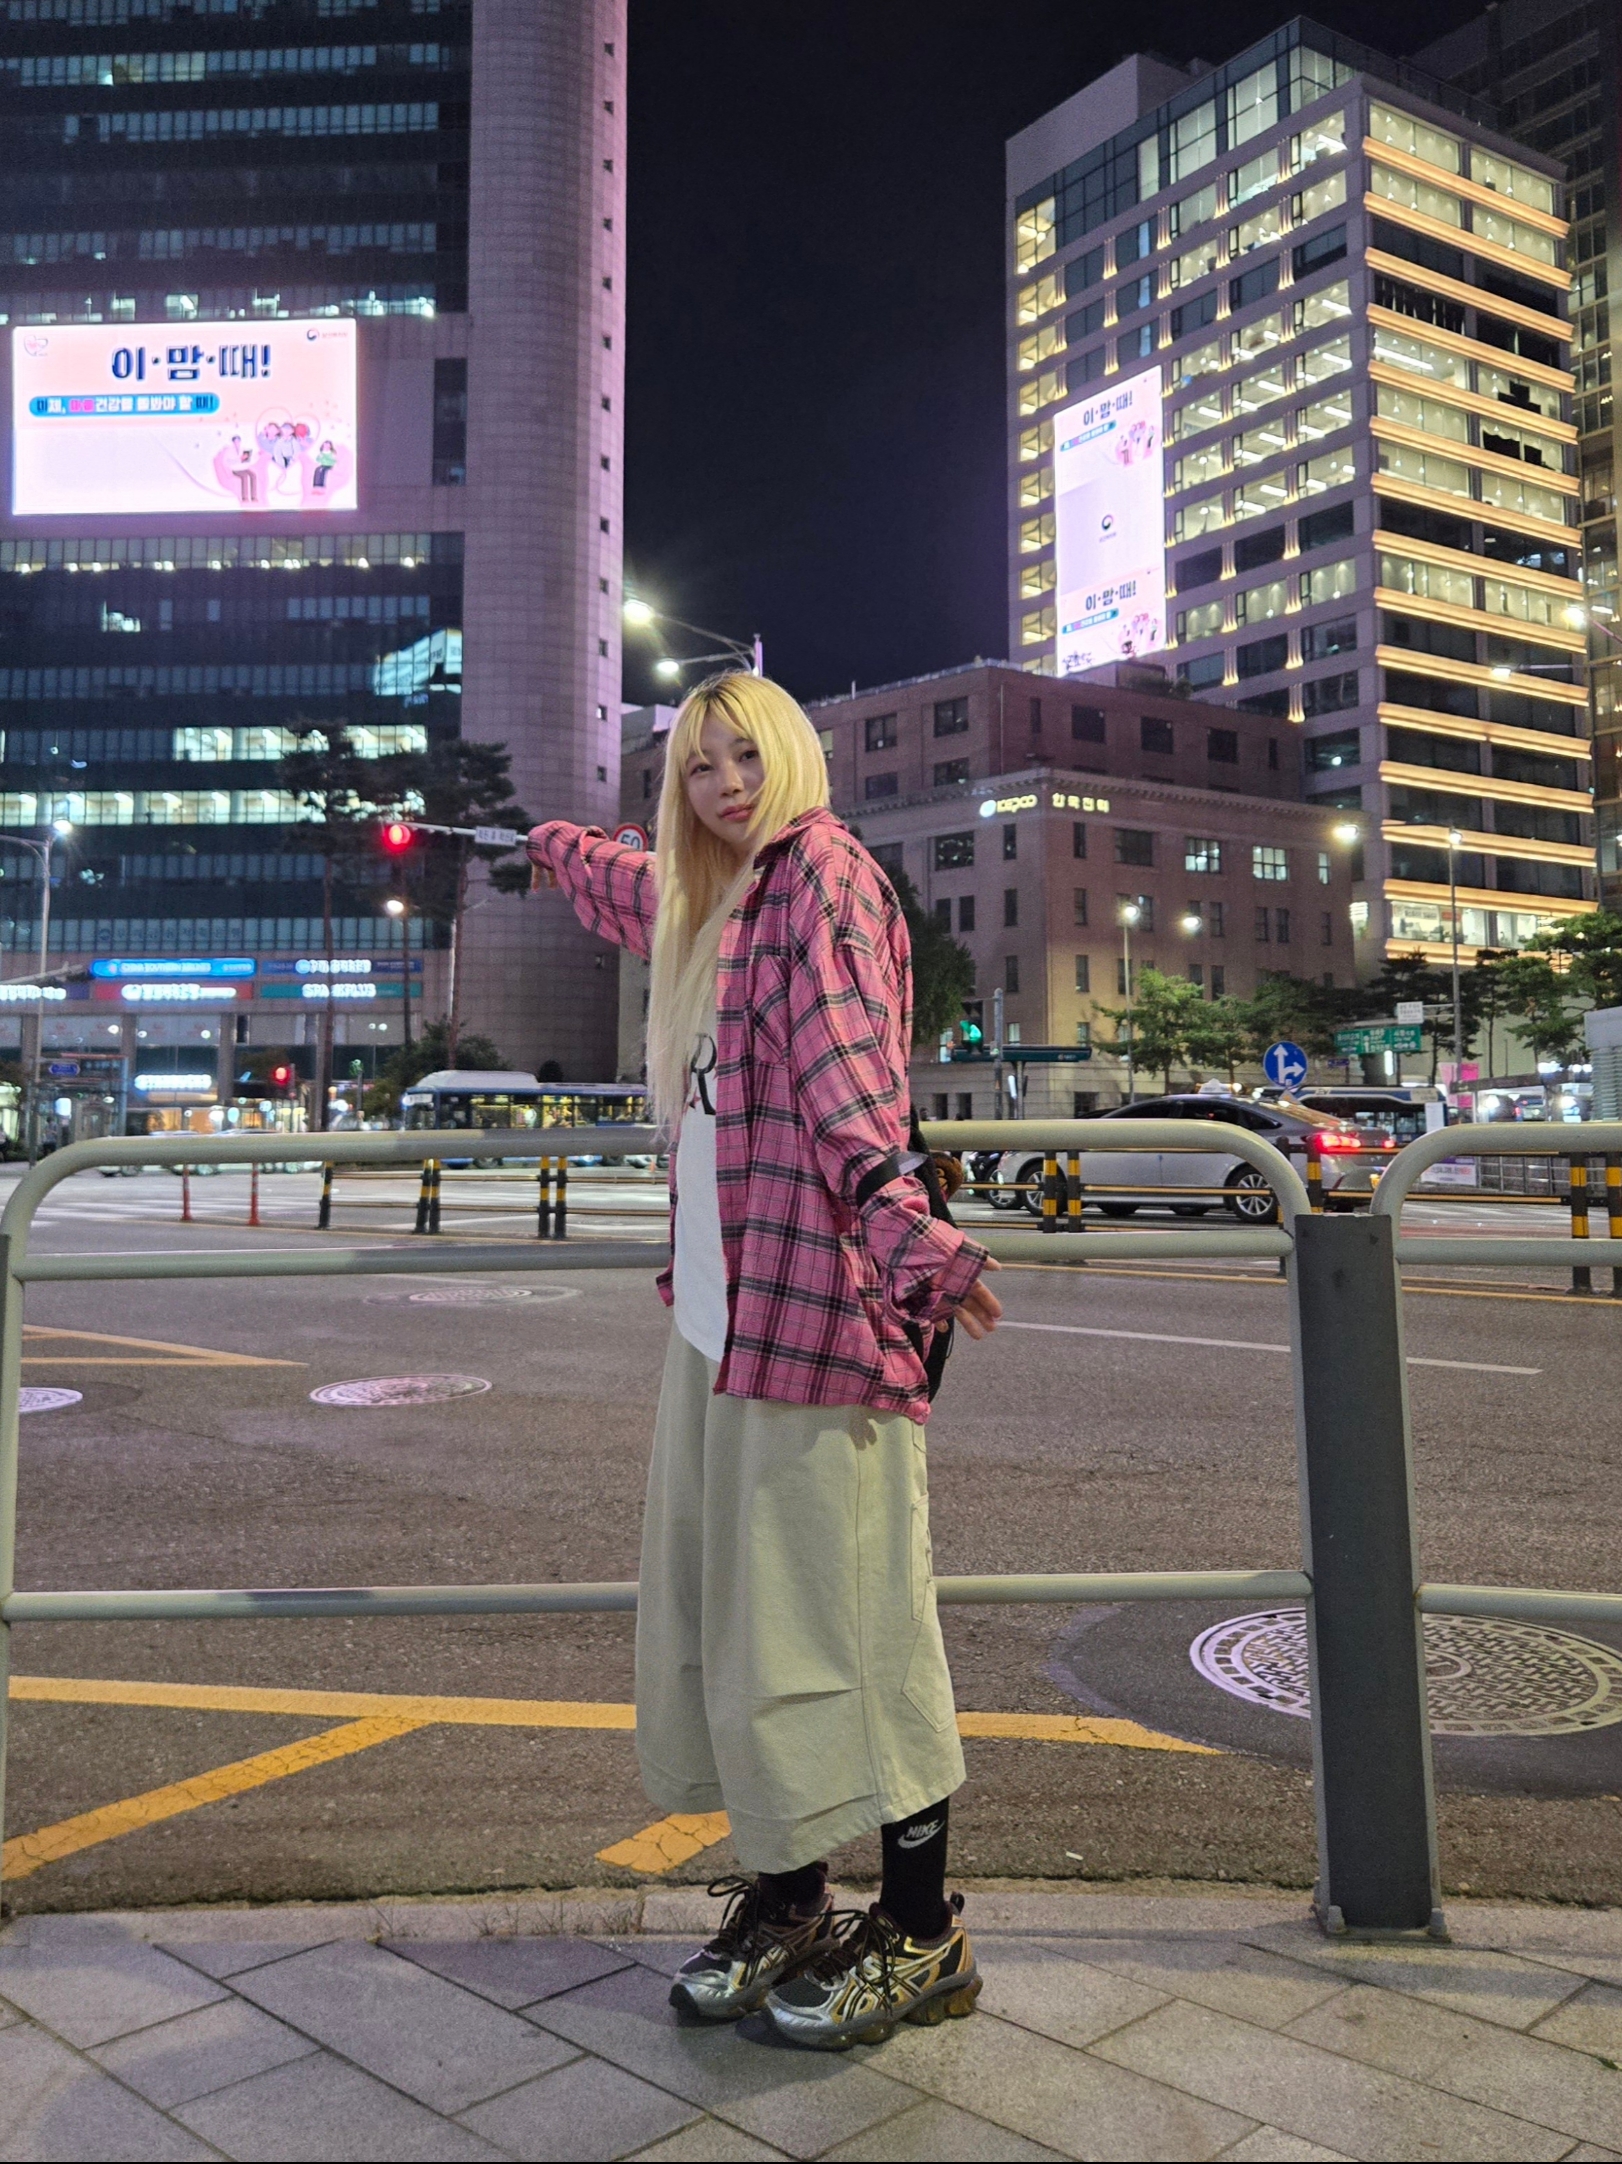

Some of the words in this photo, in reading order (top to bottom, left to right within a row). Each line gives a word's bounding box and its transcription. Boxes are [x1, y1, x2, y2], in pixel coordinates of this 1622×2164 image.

[996, 794, 1037, 812] KEPCO
[620, 833, 641, 850] 50
[905, 1818, 939, 1838] NIKE
